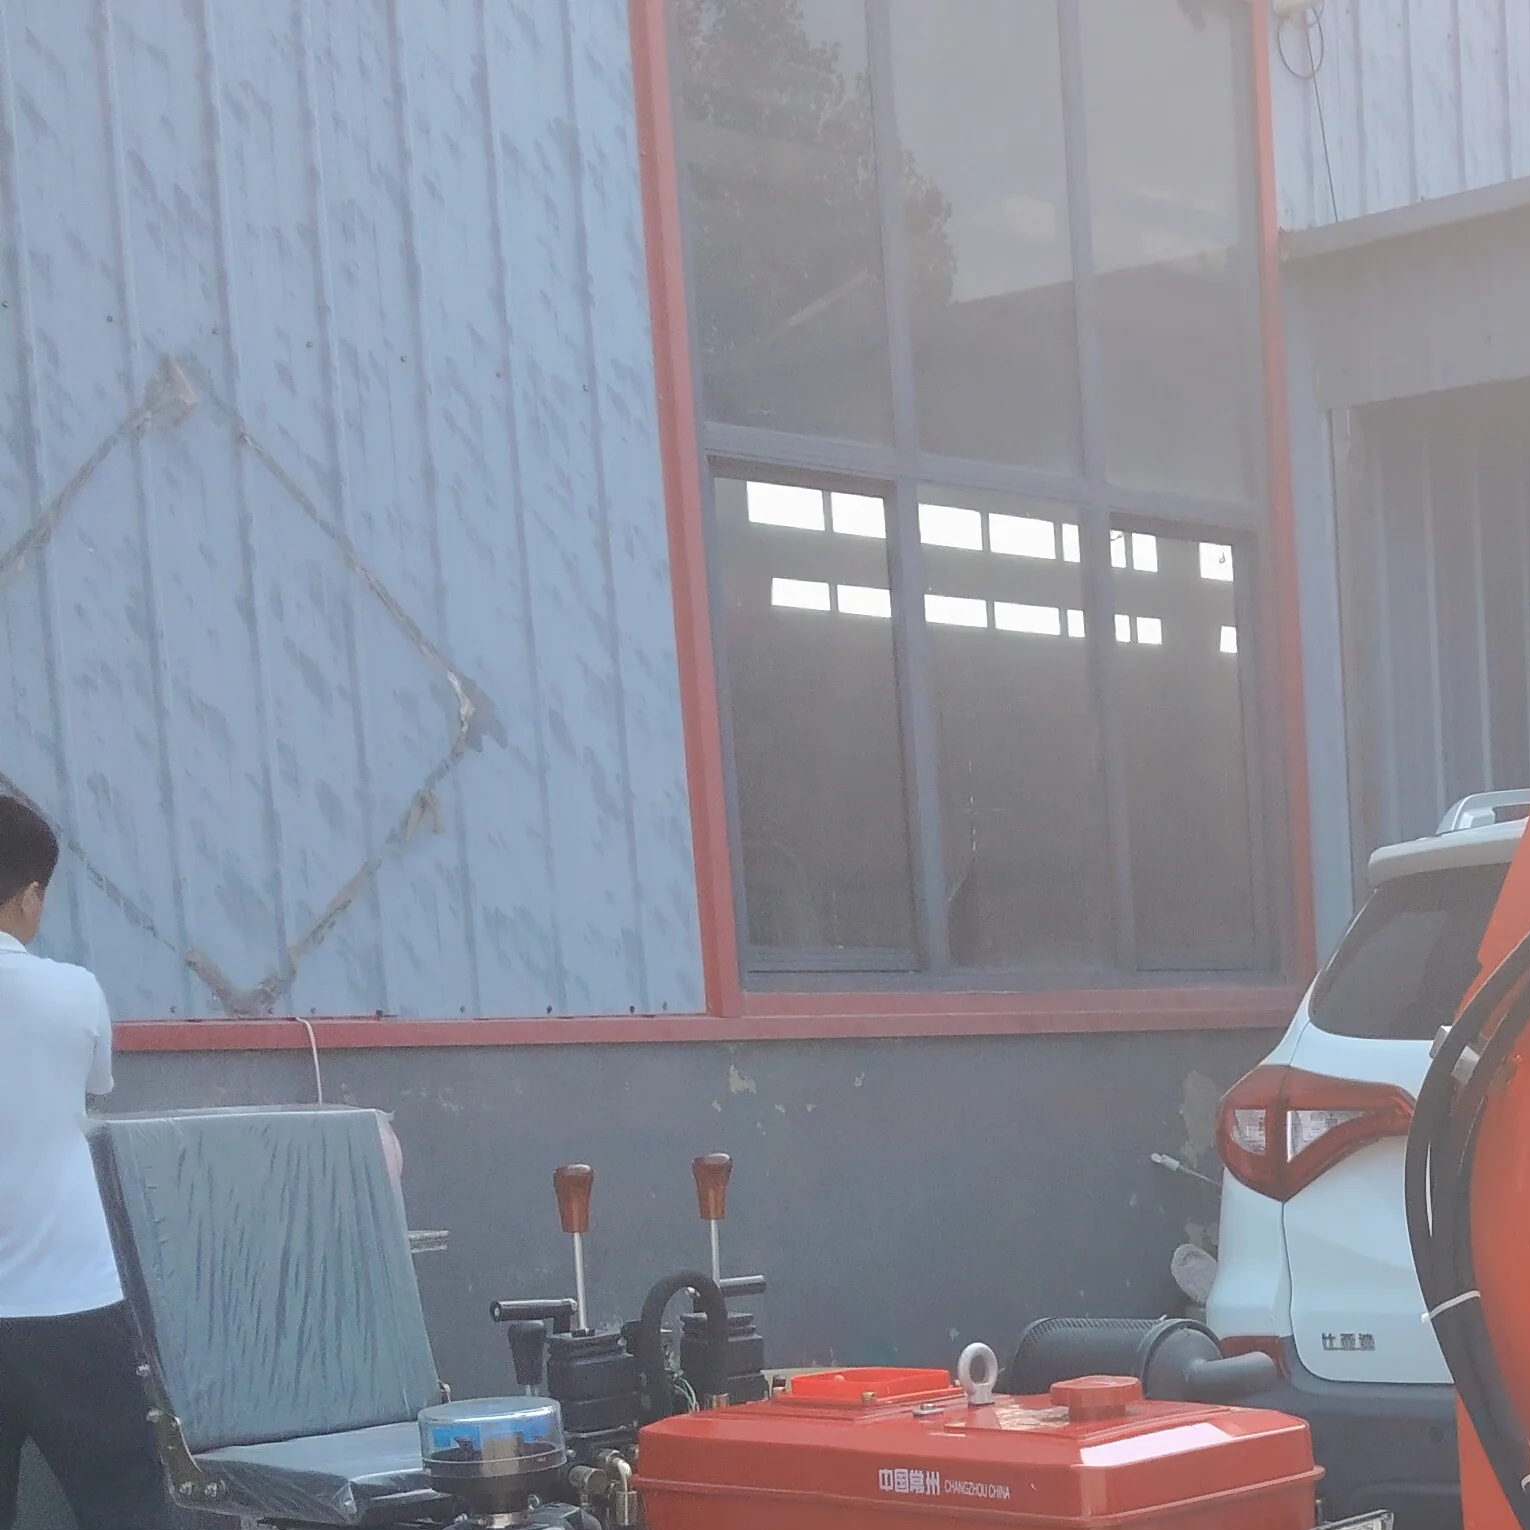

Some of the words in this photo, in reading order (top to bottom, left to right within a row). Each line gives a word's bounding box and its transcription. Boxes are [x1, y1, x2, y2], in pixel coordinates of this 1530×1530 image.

[878, 1468, 940, 1496] 中国常州
[944, 1479, 988, 1498] CHANGZHOU
[988, 1484, 1011, 1500] CHINA
